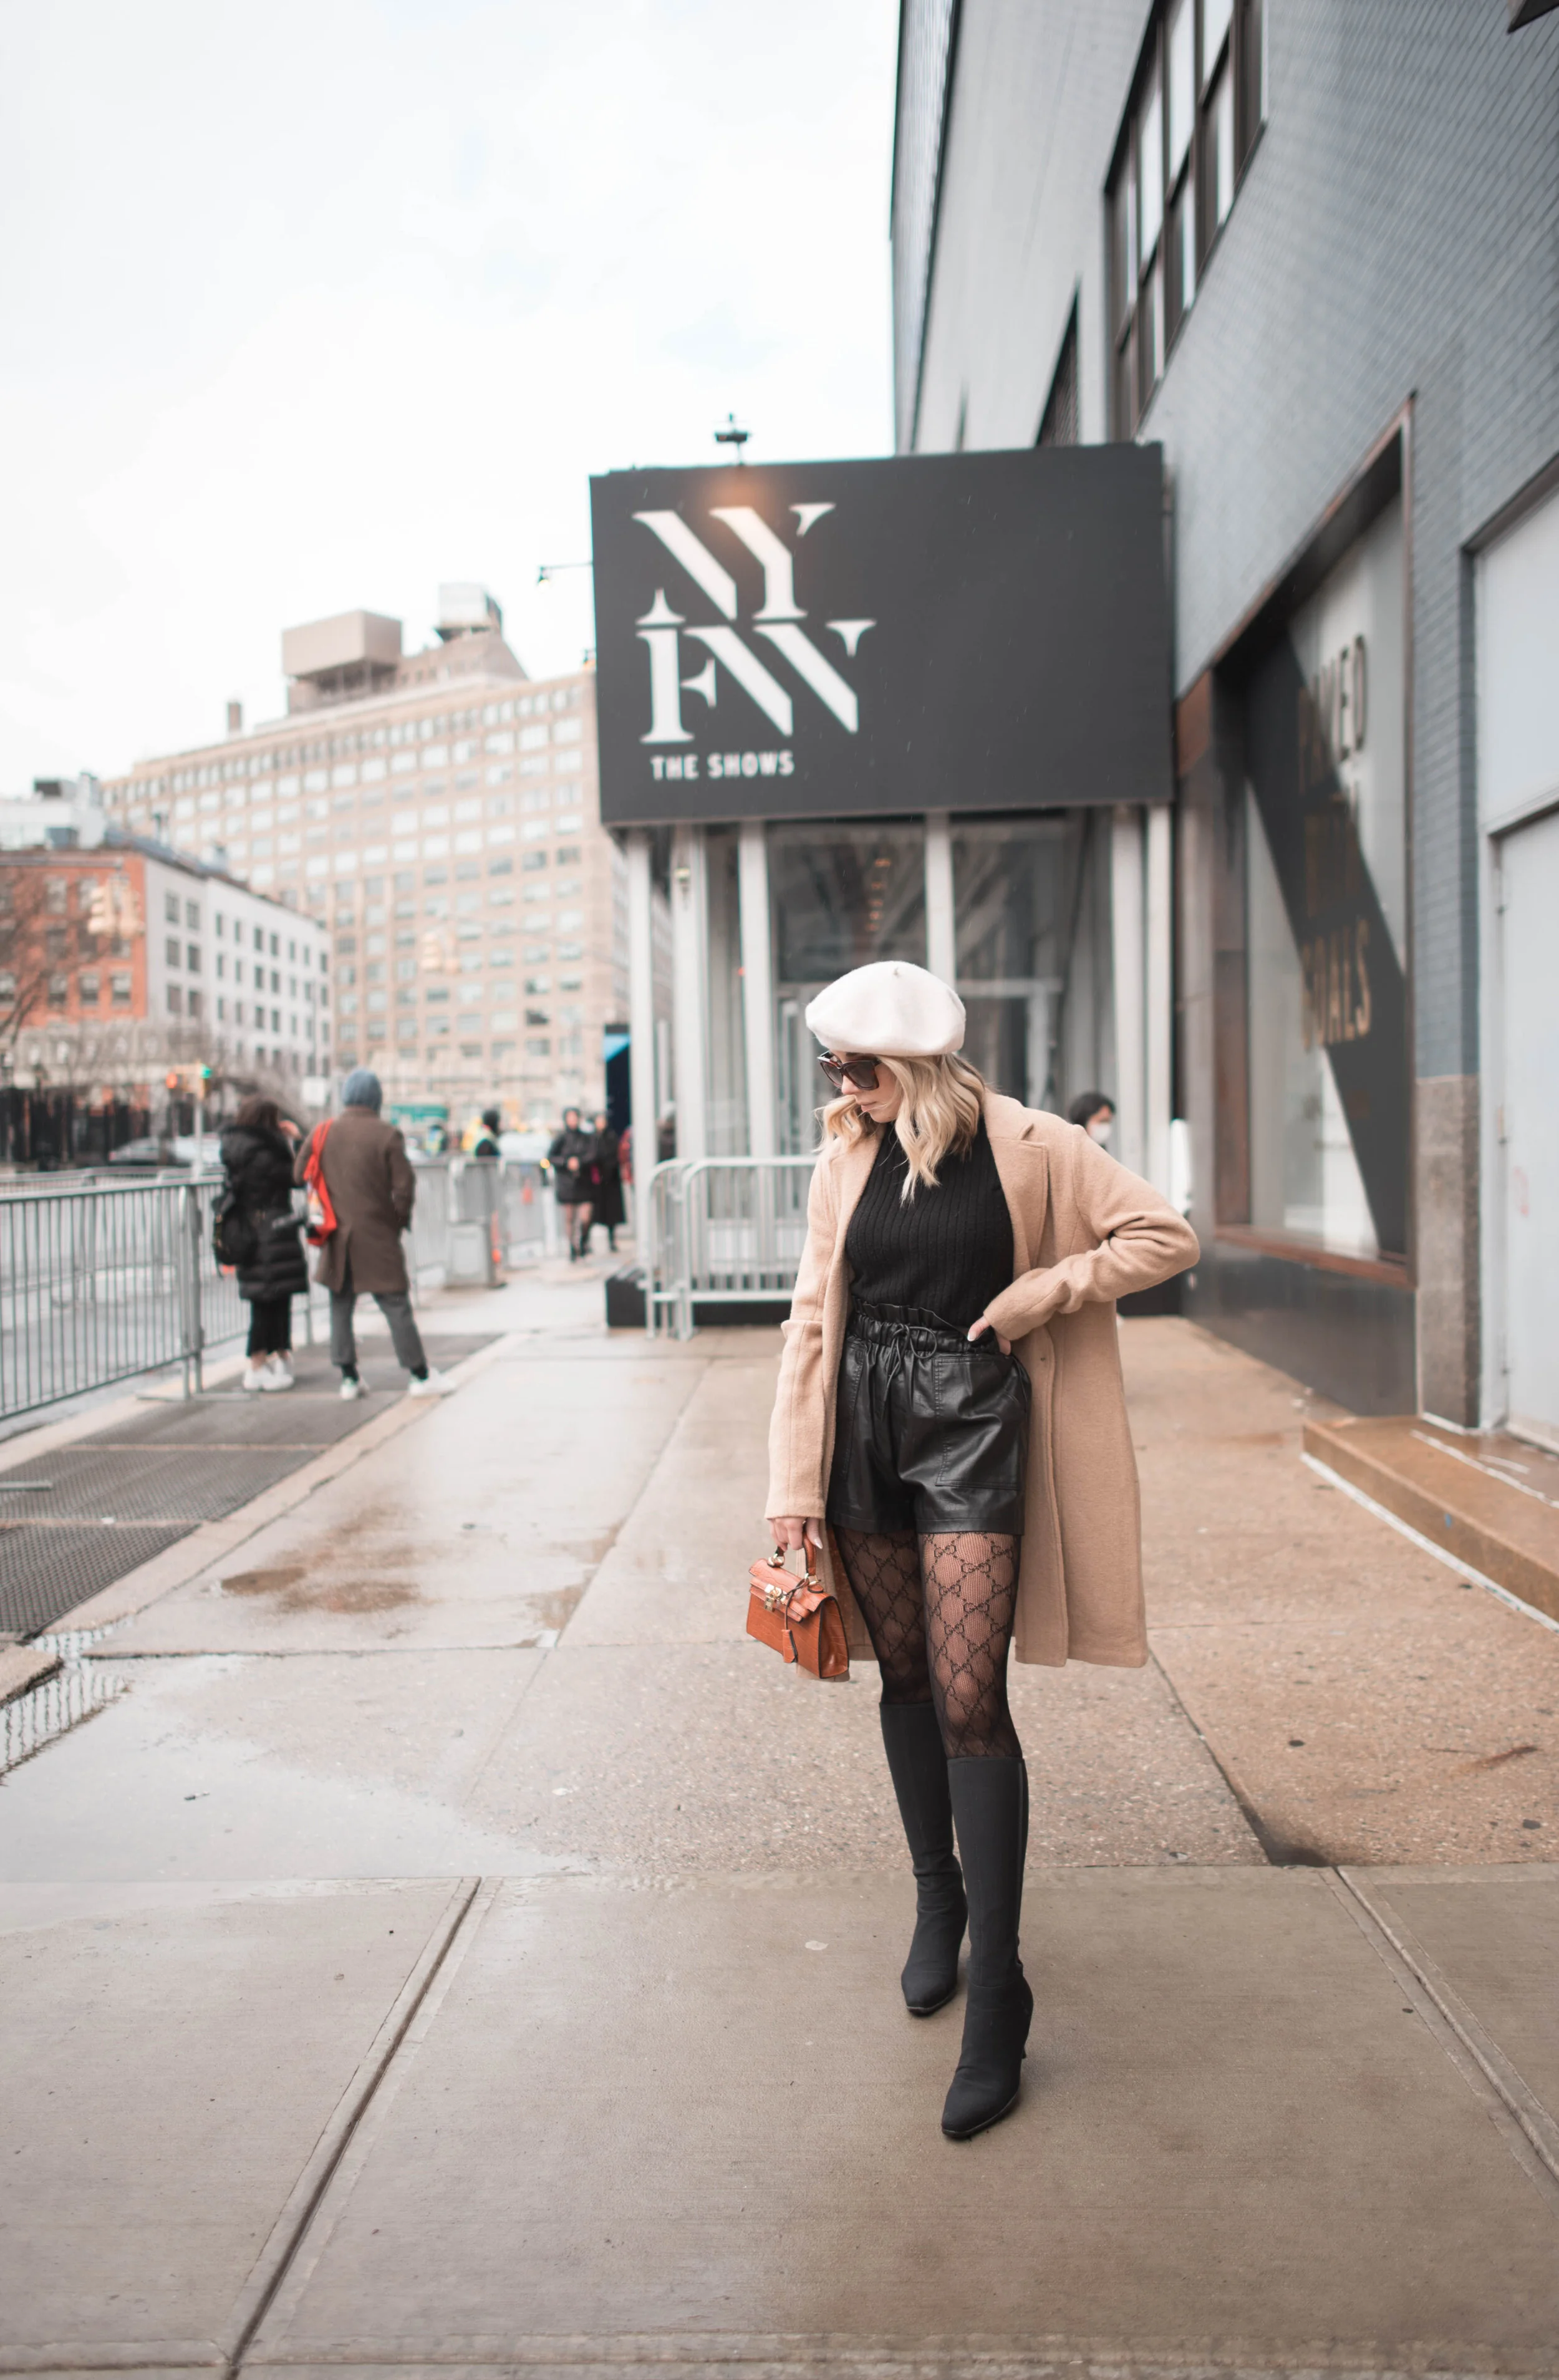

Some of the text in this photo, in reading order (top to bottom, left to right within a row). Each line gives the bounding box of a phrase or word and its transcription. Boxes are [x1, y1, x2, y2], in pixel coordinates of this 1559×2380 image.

[632, 502, 836, 626] NY
[650, 750, 794, 780] THE SHOWS
